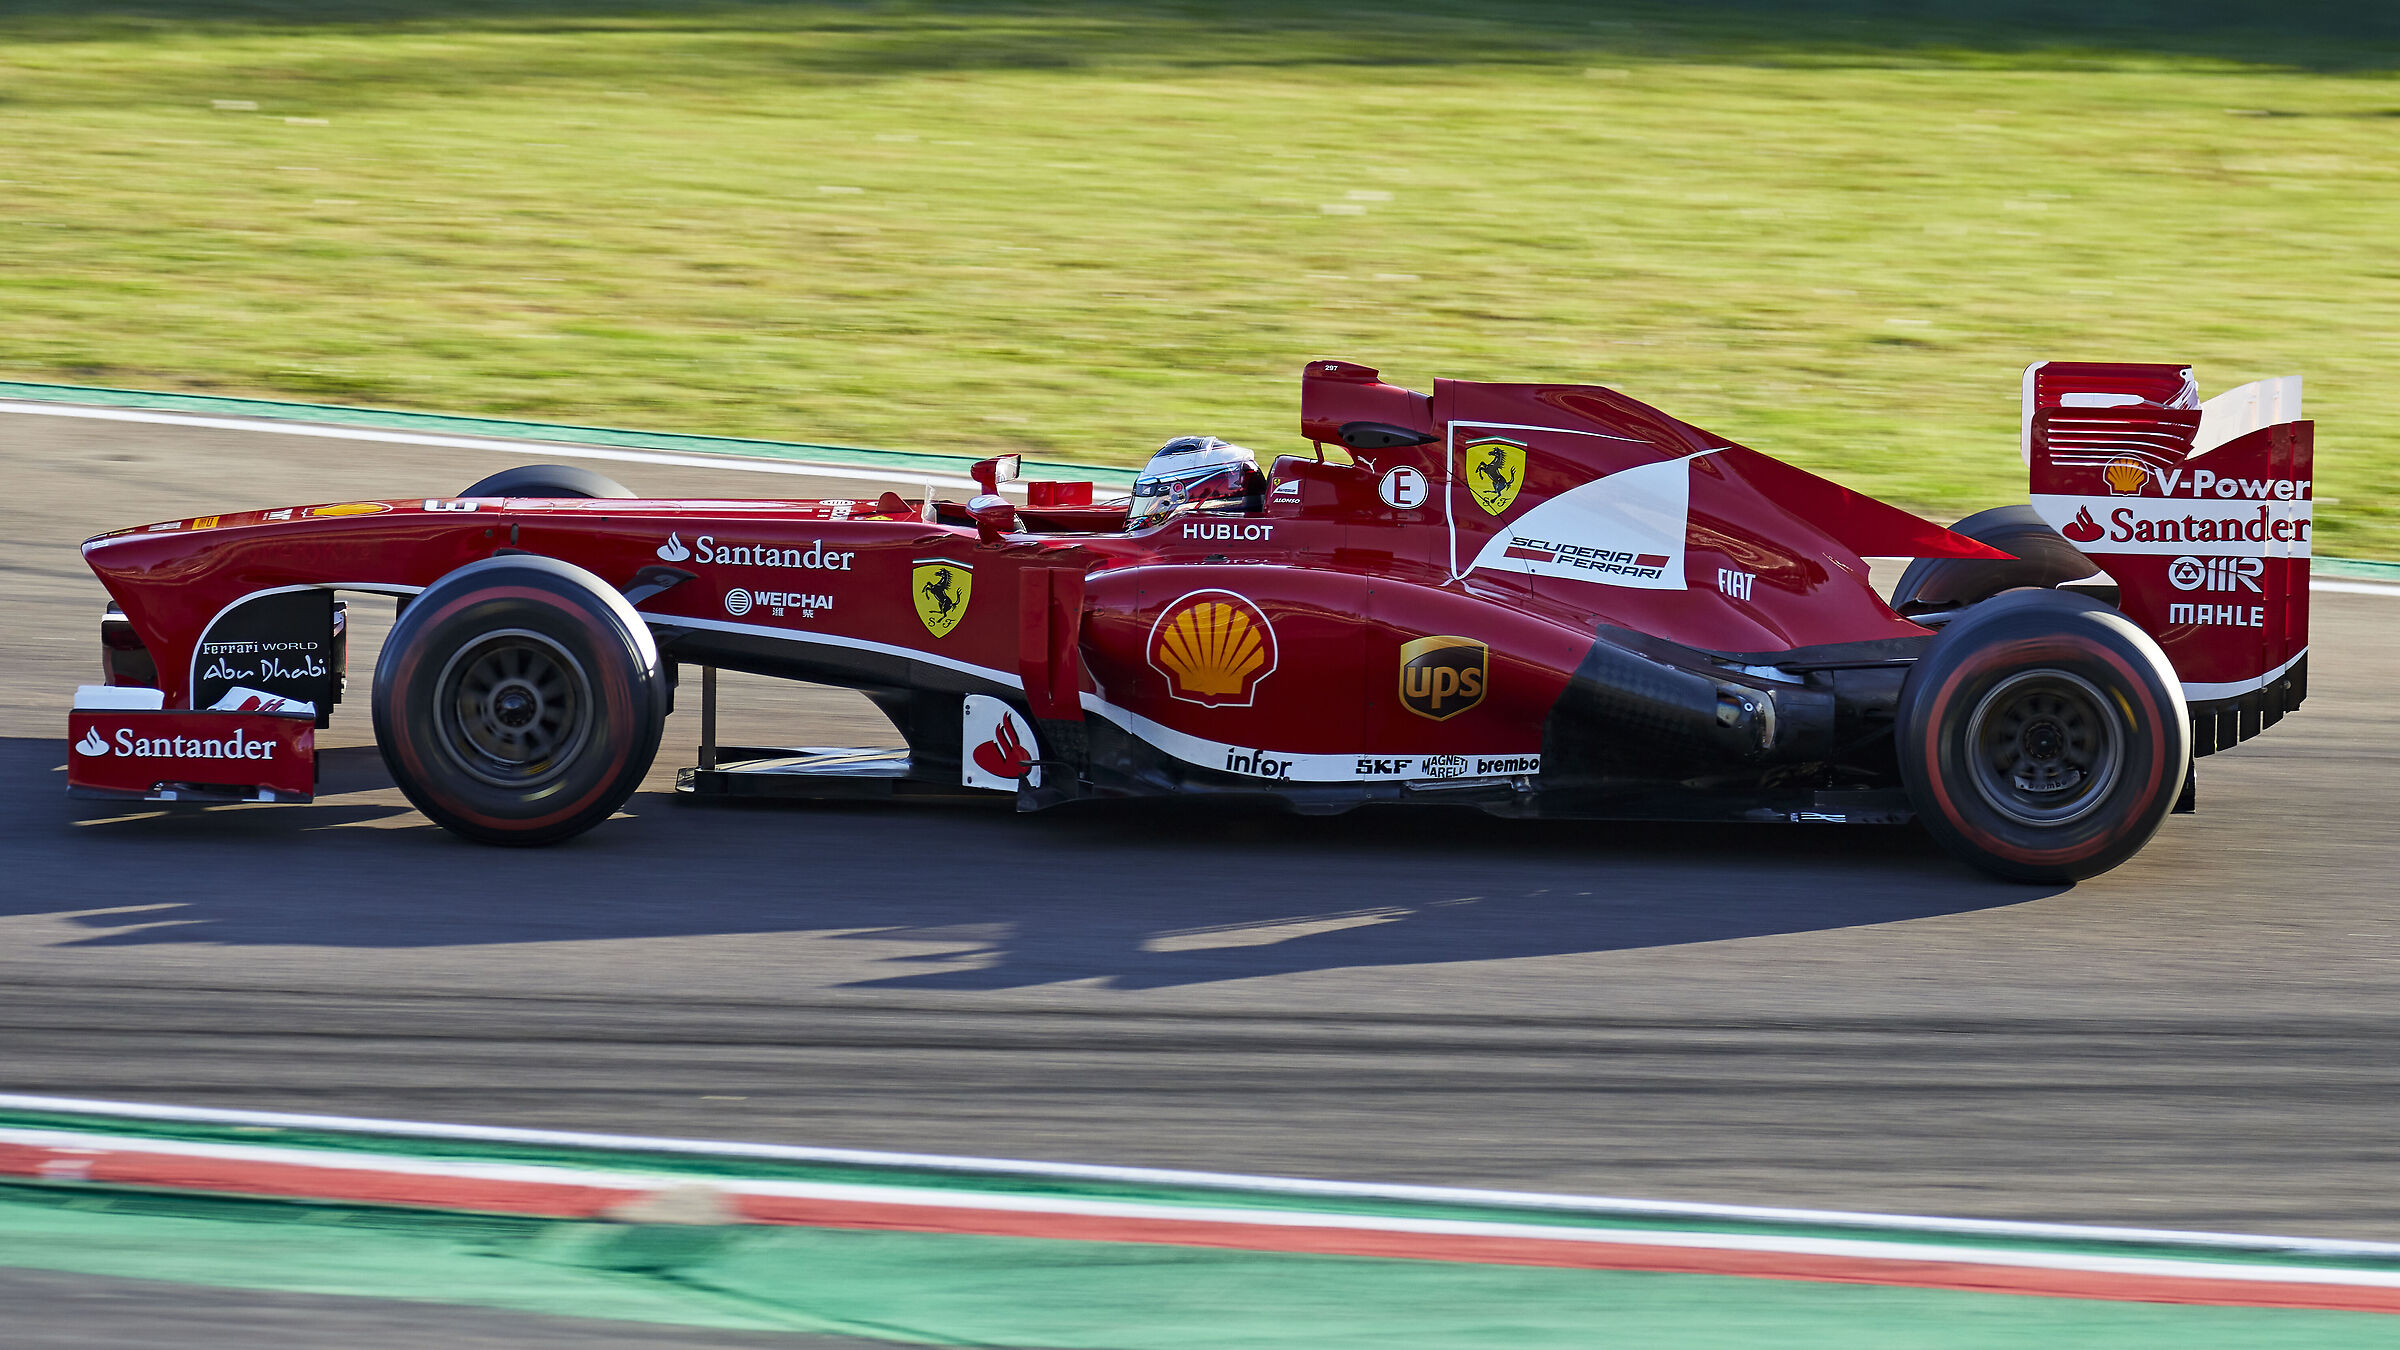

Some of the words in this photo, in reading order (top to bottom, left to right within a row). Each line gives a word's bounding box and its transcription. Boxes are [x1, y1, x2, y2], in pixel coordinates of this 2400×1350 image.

[1394, 471, 1412, 504] E
[2154, 469, 2311, 500] V-Power
[1183, 523, 1274, 541] HUBLOT
[2110, 505, 2311, 543] Santander
[694, 535, 855, 571] Santander
[1510, 536, 1634, 564] SCUDERIA
[1557, 554, 1663, 580] FERRARI
[1718, 568, 1757, 602] FIAT
[754, 591, 833, 610] WEICHAI
[2169, 603, 2264, 628] MAHLE
[203, 641, 259, 655] Ferrari
[262, 642, 318, 651] WORLD
[203, 657, 255, 681] Abu
[260, 654, 327, 682] Dhabi
[1405, 666, 1481, 709] ups
[114, 728, 278, 760] Santander
[1226, 747, 1293, 778] infor
[1355, 759, 1413, 775] SKF
[1477, 757, 1540, 775] brembo
